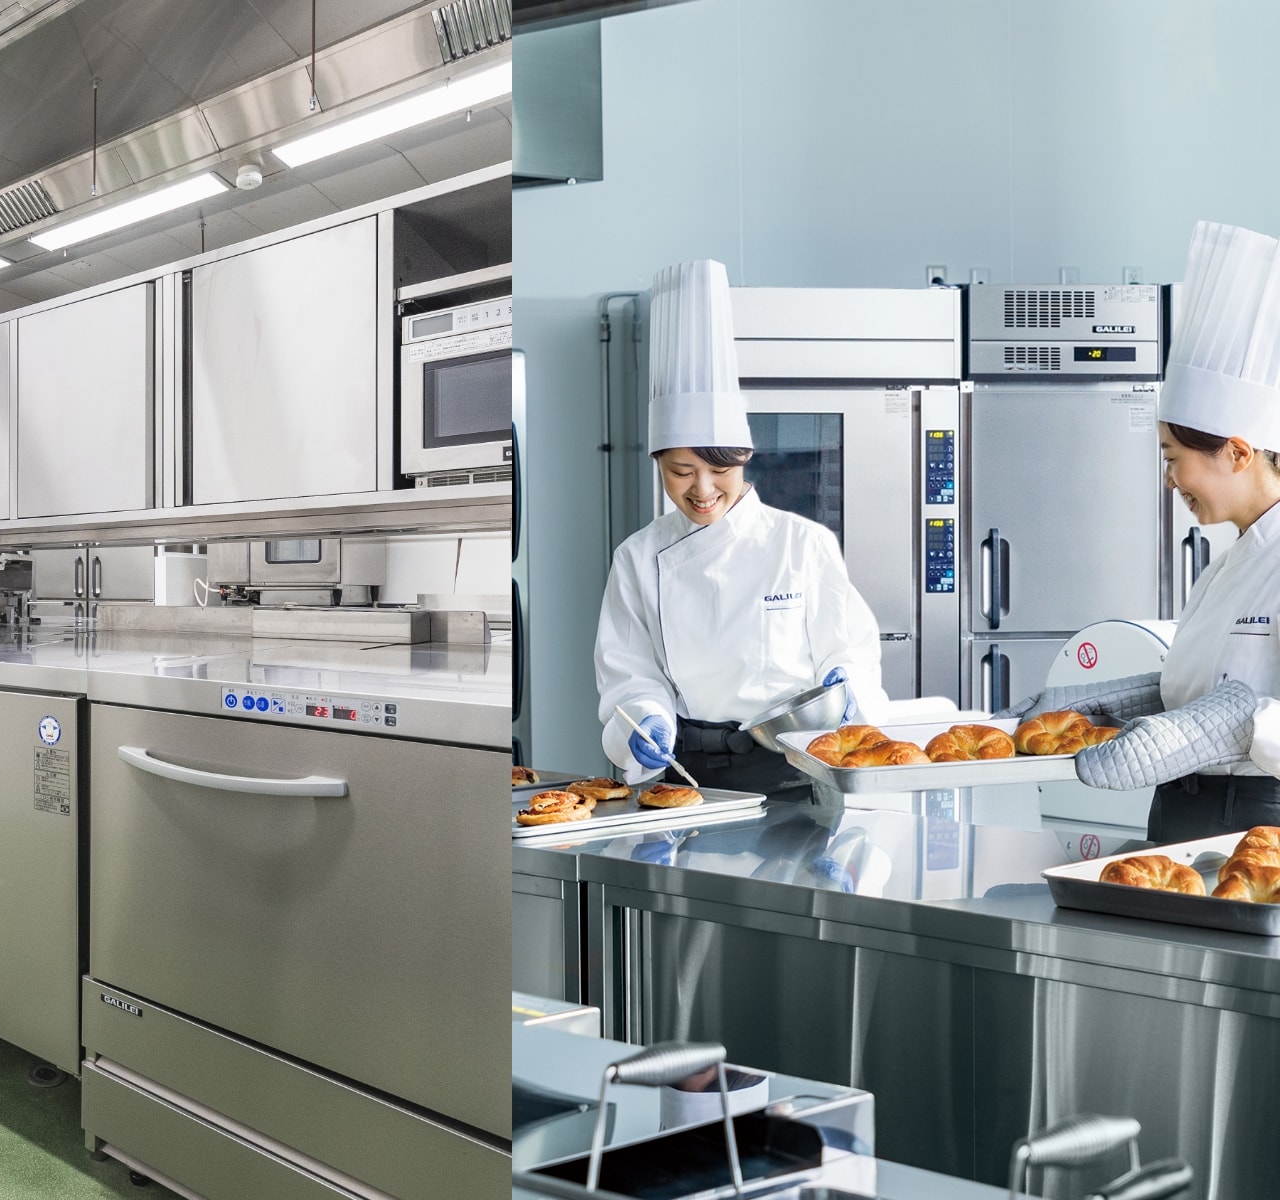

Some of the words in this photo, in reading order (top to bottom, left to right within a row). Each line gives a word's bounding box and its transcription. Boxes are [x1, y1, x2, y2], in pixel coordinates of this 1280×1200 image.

[496, 308, 501, 317] 2
[1236, 616, 1270, 625] GALILEI
[314, 706, 329, 718] 23
[104, 995, 139, 1015] GALILEI
